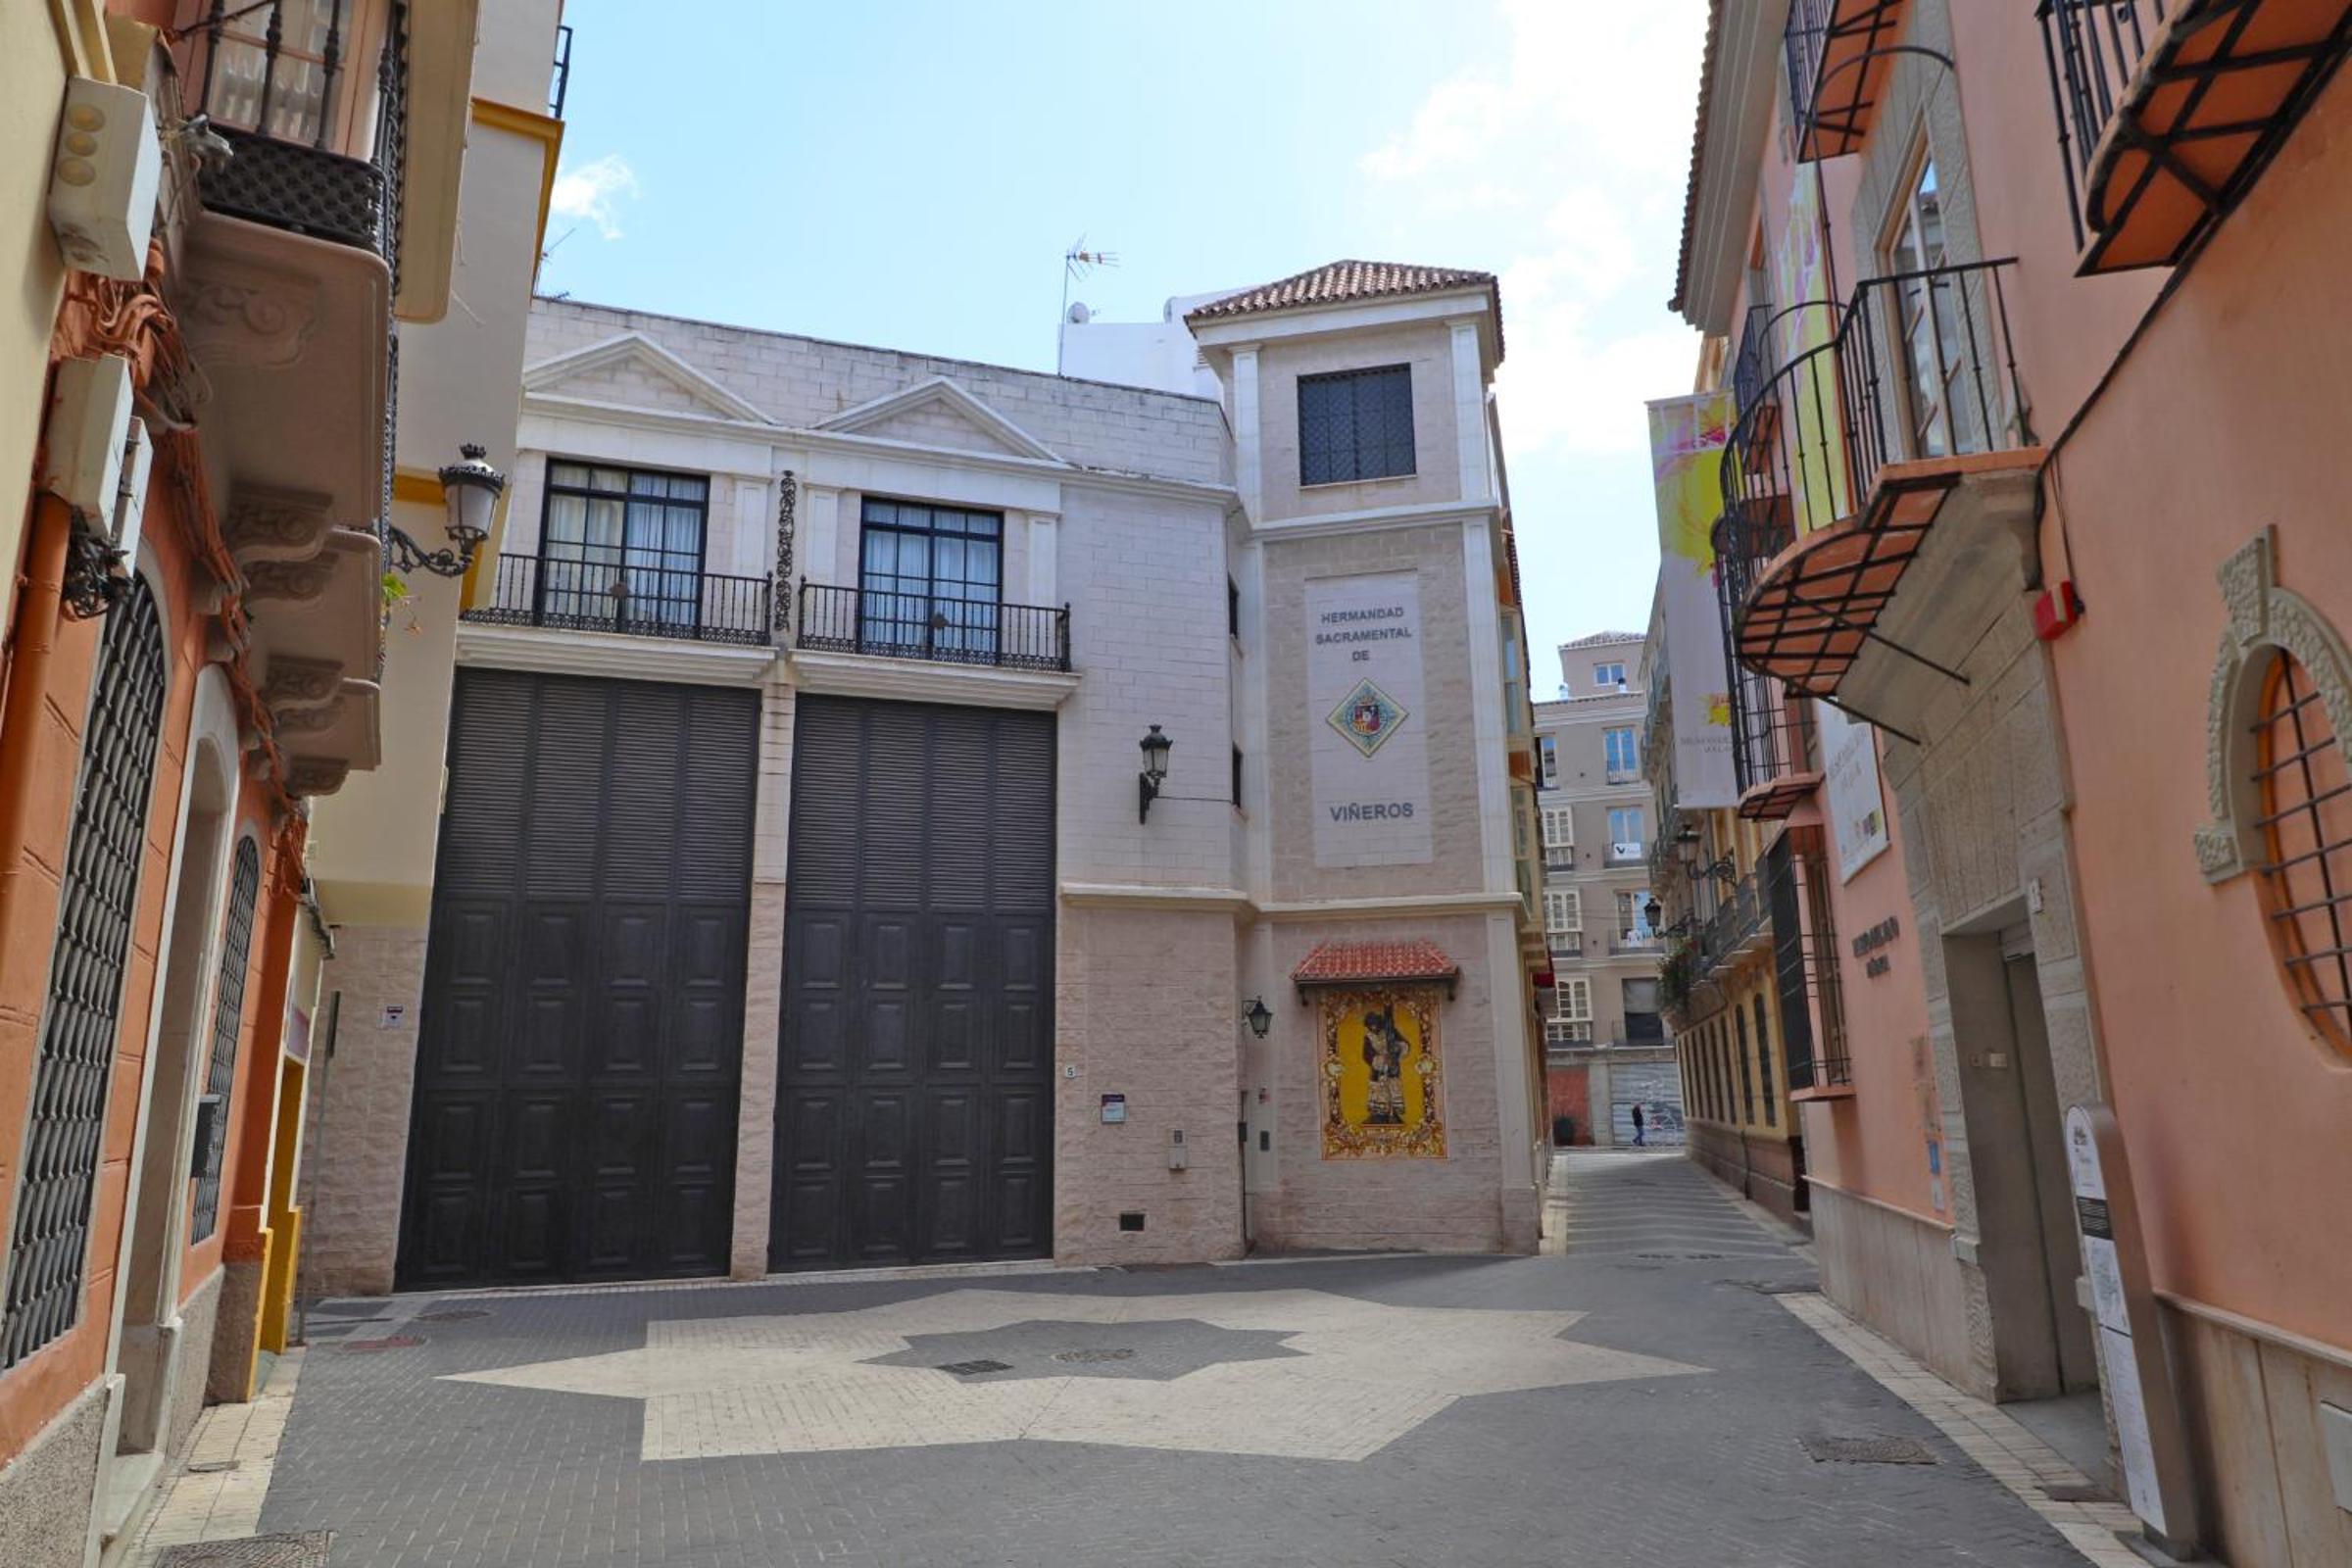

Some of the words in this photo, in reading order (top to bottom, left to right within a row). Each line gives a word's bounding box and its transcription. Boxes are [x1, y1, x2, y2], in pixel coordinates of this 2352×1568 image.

[1321, 608, 1404, 623] HERMANDAD
[1316, 627, 1412, 645] SACRAMENTAL
[1352, 650, 1369, 661] DE
[1330, 803, 1413, 821] VIÑEROS
